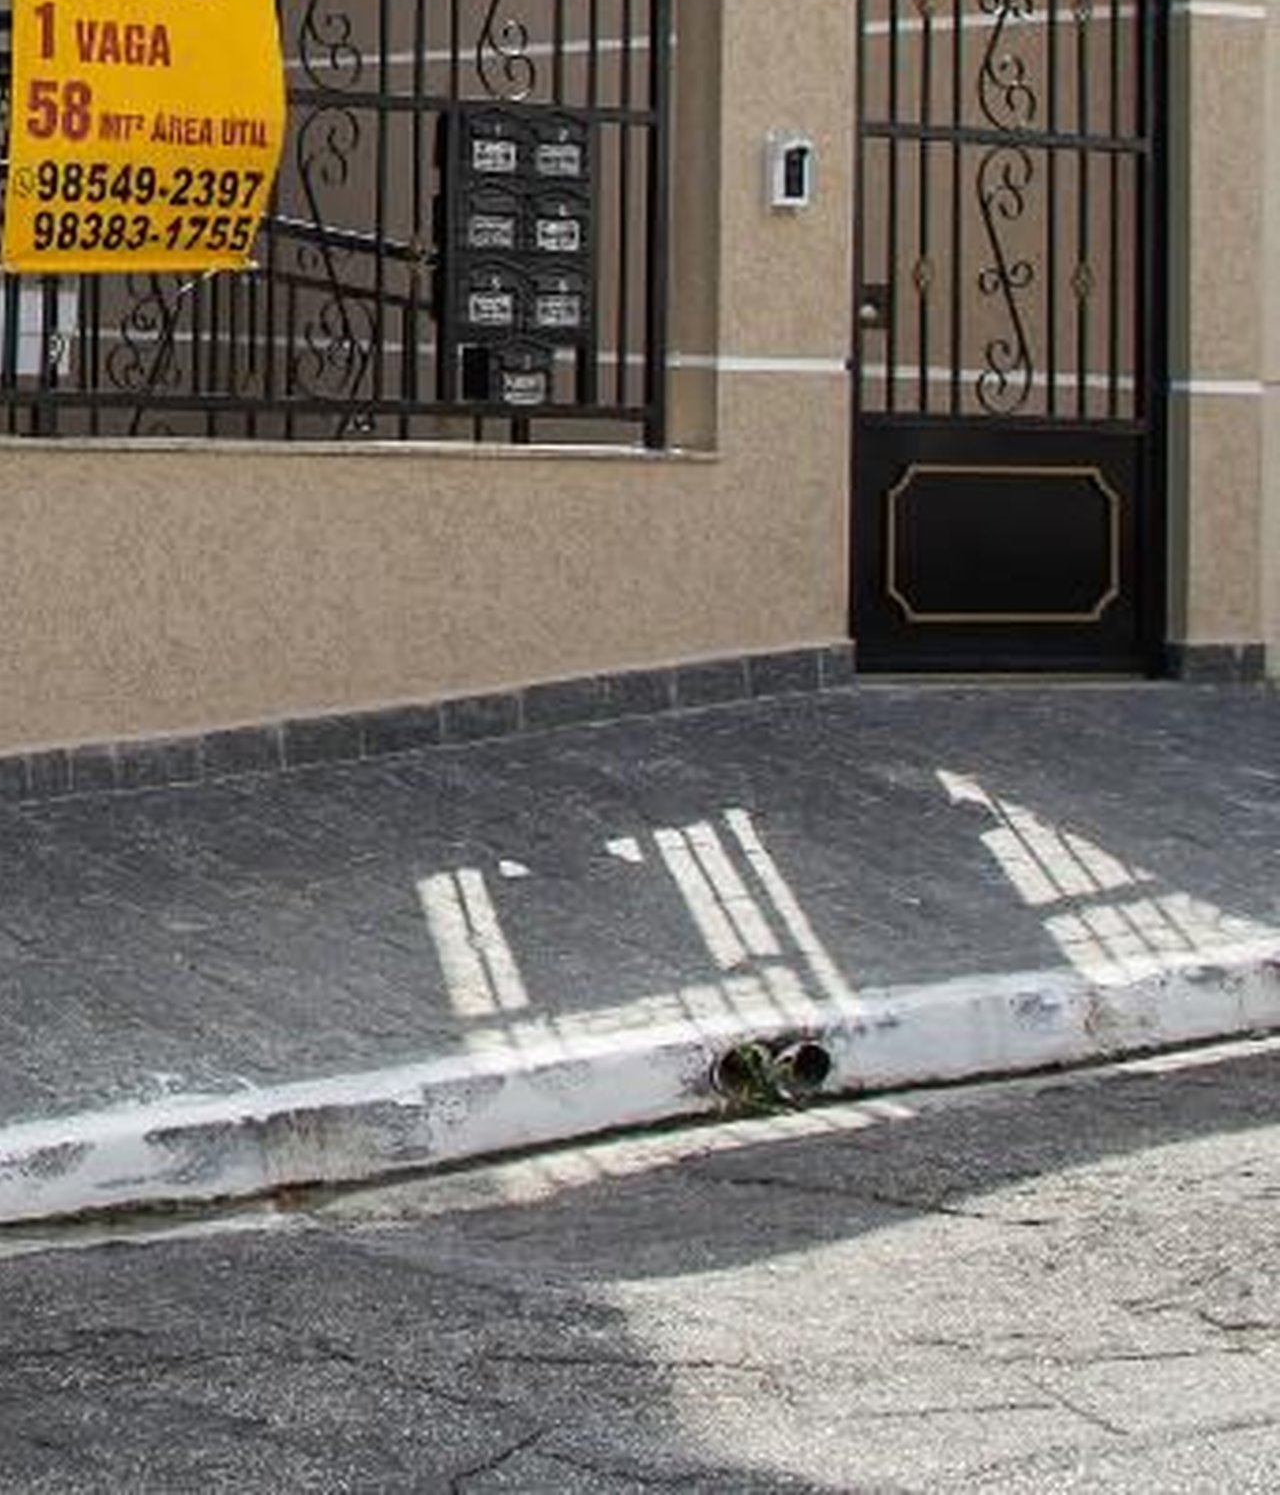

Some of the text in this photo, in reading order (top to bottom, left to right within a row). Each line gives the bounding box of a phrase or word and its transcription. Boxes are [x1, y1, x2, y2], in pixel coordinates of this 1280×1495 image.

[35, 1, 171, 67] 1 VAGA
[27, 80, 92, 142] 58
[37, 160, 264, 208] 98549-2397
[34, 211, 252, 251] 98383-1755
